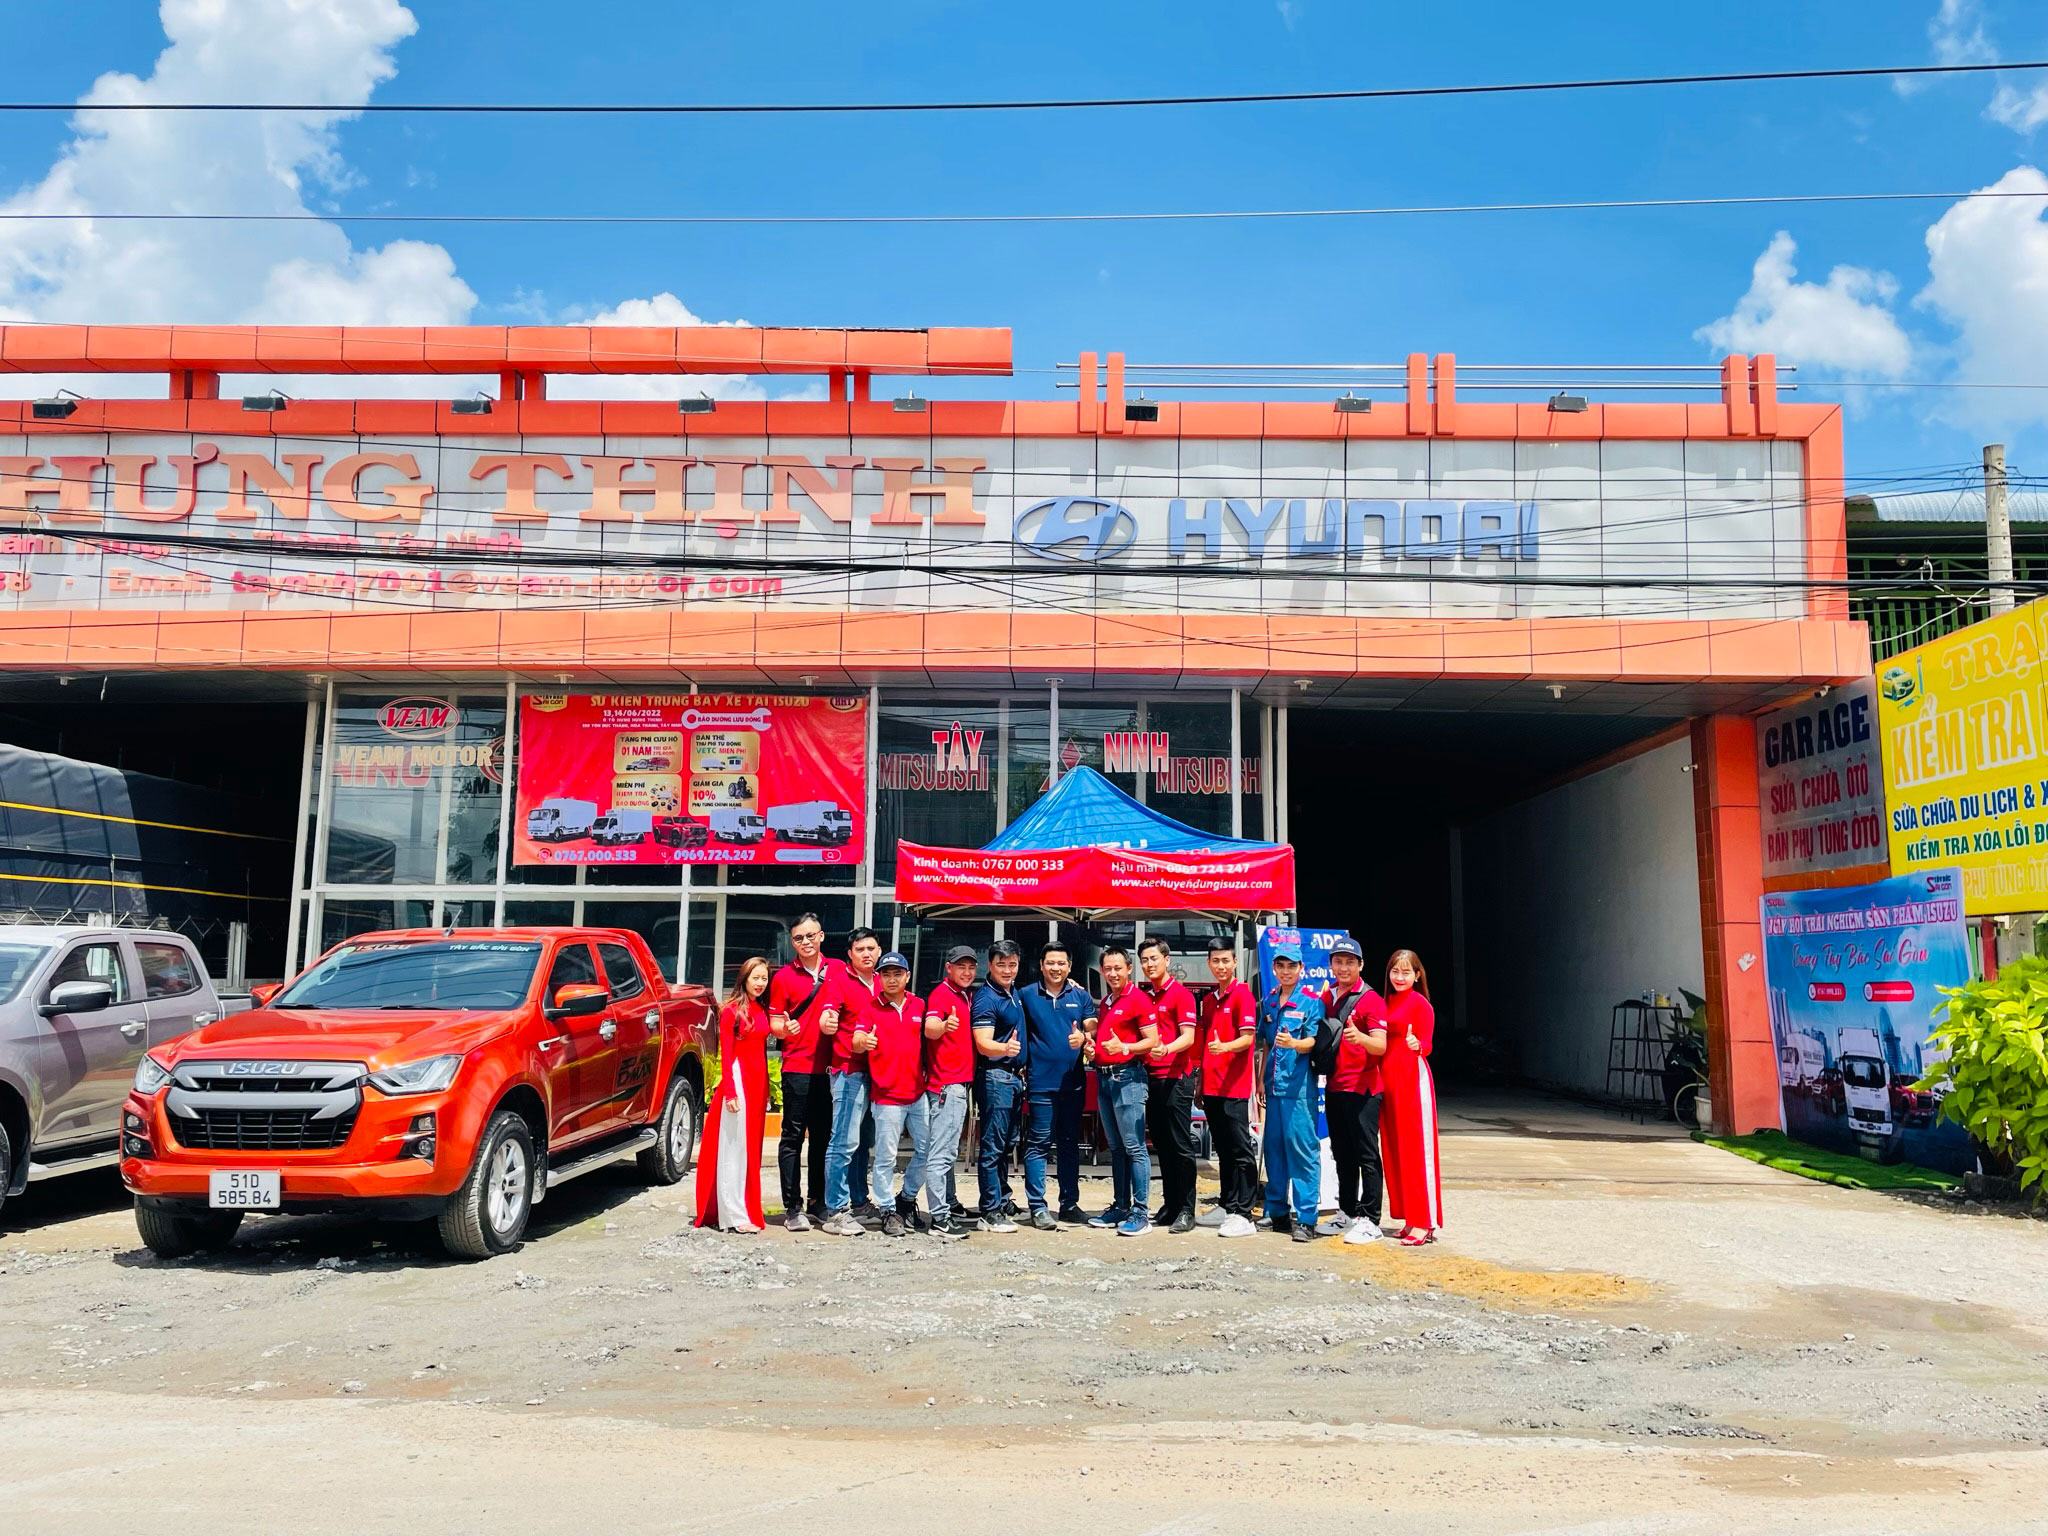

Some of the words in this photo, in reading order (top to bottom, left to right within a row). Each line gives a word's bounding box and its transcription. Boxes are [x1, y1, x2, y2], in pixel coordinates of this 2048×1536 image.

[469, 453, 988, 539] THỊNH
[1169, 498, 1540, 562] HYUNDAI
[774, 695, 812, 708] ISUZU
[386, 706, 452, 729] VEAM
[1764, 695, 1871, 769] GARAGE
[1890, 692, 1968, 790] KIỂM
[1967, 689, 2037, 772] TRA
[340, 745, 404, 767] VEAM
[410, 745, 494, 767] MOTOR
[932, 720, 985, 772] TÂY
[1104, 731, 1169, 773] NINH
[693, 789, 716, 801] 10%
[1770, 773, 1798, 816] SỬA
[1801, 764, 1842, 809] CHỮA
[1847, 752, 1870, 799] ÔTÔ
[1893, 802, 1919, 833] SỬA
[1921, 796, 1957, 828] CHỮA
[1959, 794, 1980, 821] DU
[1983, 786, 2019, 821] LỊCH
[2023, 783, 2036, 809] &
[1767, 827, 1790, 863] BÁN
[1792, 824, 1815, 863] PHỤ
[1817, 817, 1849, 856] TÙNG
[1851, 807, 1880, 851] ÔTÔ
[1906, 834, 1940, 862] KIỂM
[1943, 836, 1971, 857] TRA
[1973, 827, 2002, 853] XÓA
[2005, 819, 2030, 848] LỖI
[674, 849, 756, 862] 0969.724.247
[913, 857, 938, 869] Kinh
[942, 859, 979, 870] doanh:
[982, 859, 1012, 870] 0767
[1015, 860, 1039, 871] 000
[1042, 860, 1065, 872] 333
[1111, 861, 1133, 874] Hậu
[913, 873, 1039, 888] www.taybacsaigon.com
[1111, 878, 1273, 892] www.xechuyendungisuzu.com
[1926, 899, 1958, 923] ISUZU
[228, 1062, 302, 1075] ISUZU
[230, 1174, 260, 1190] 51D
[218, 1190, 272, 1206] 585.84
